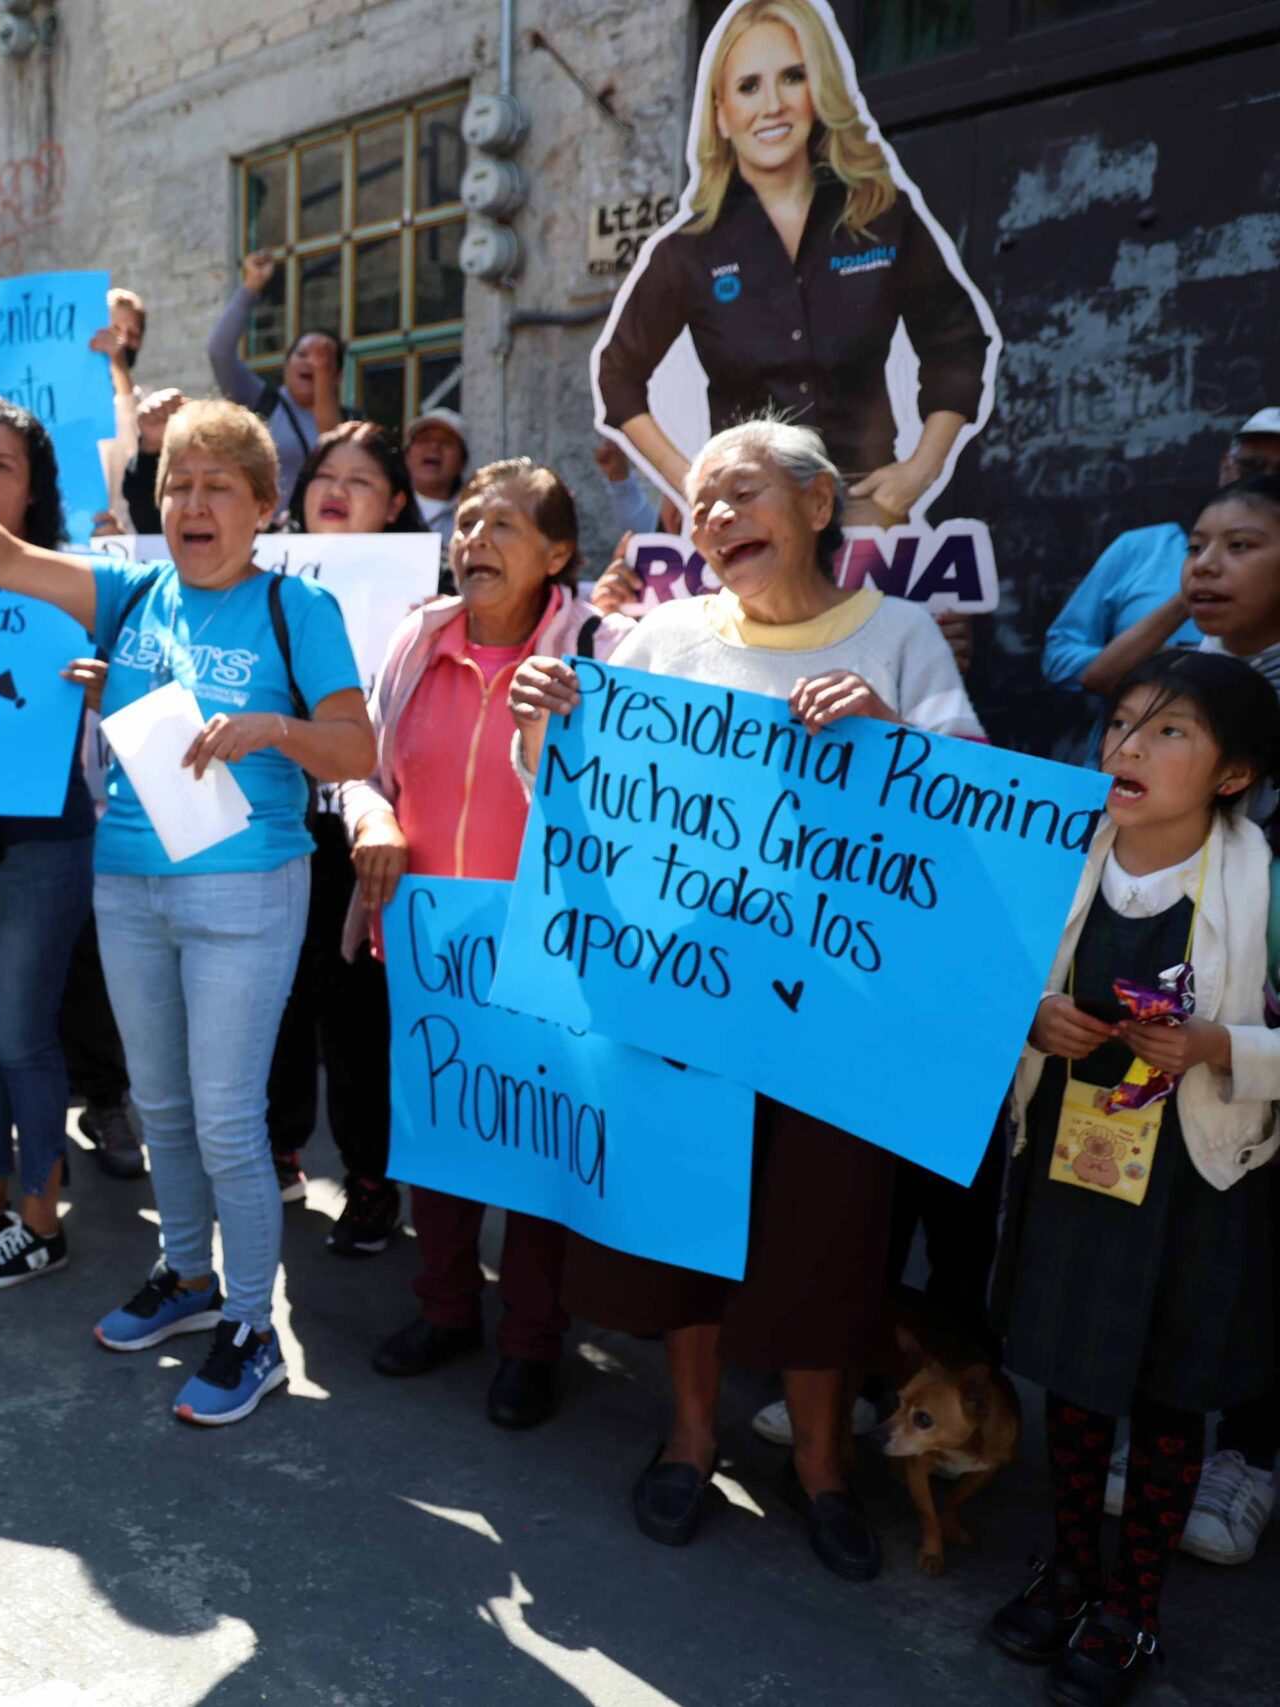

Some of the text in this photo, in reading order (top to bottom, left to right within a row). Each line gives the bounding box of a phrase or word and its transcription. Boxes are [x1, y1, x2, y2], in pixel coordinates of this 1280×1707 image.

[543, 744, 938, 910] Muchas Gracias
[563, 658, 1107, 855] Presidenta Romina
[543, 825, 882, 973] por todos los
[543, 908, 732, 999] apoyos
[409, 1014, 606, 1199] Romina
